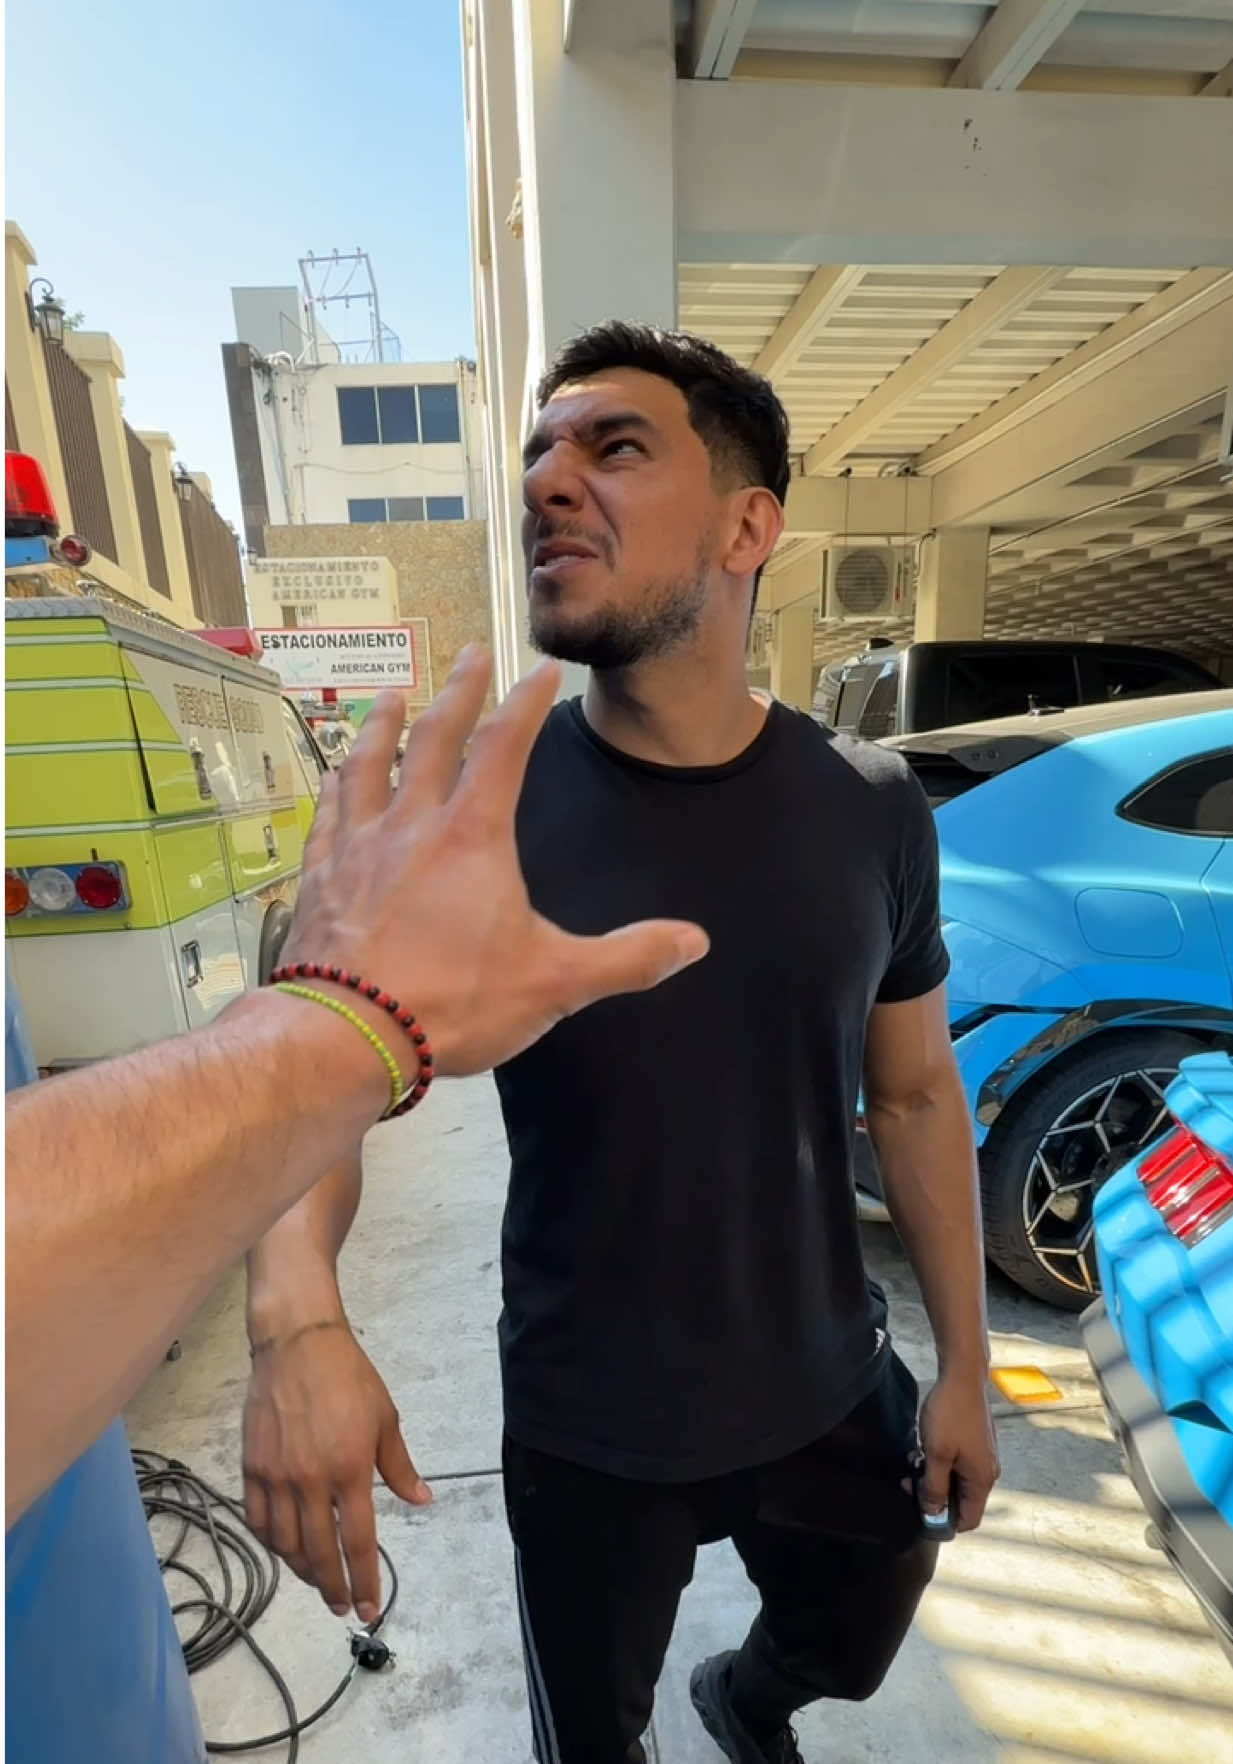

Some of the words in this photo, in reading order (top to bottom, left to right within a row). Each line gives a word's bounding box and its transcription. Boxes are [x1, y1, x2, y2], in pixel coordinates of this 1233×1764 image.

[272, 588, 346, 600] AMERICAN
[351, 587, 380, 600] GYM
[260, 632, 407, 649] ESTACIONAMIENTO
[330, 663, 385, 674] AMERICAN
[387, 663, 410, 673] GYM
